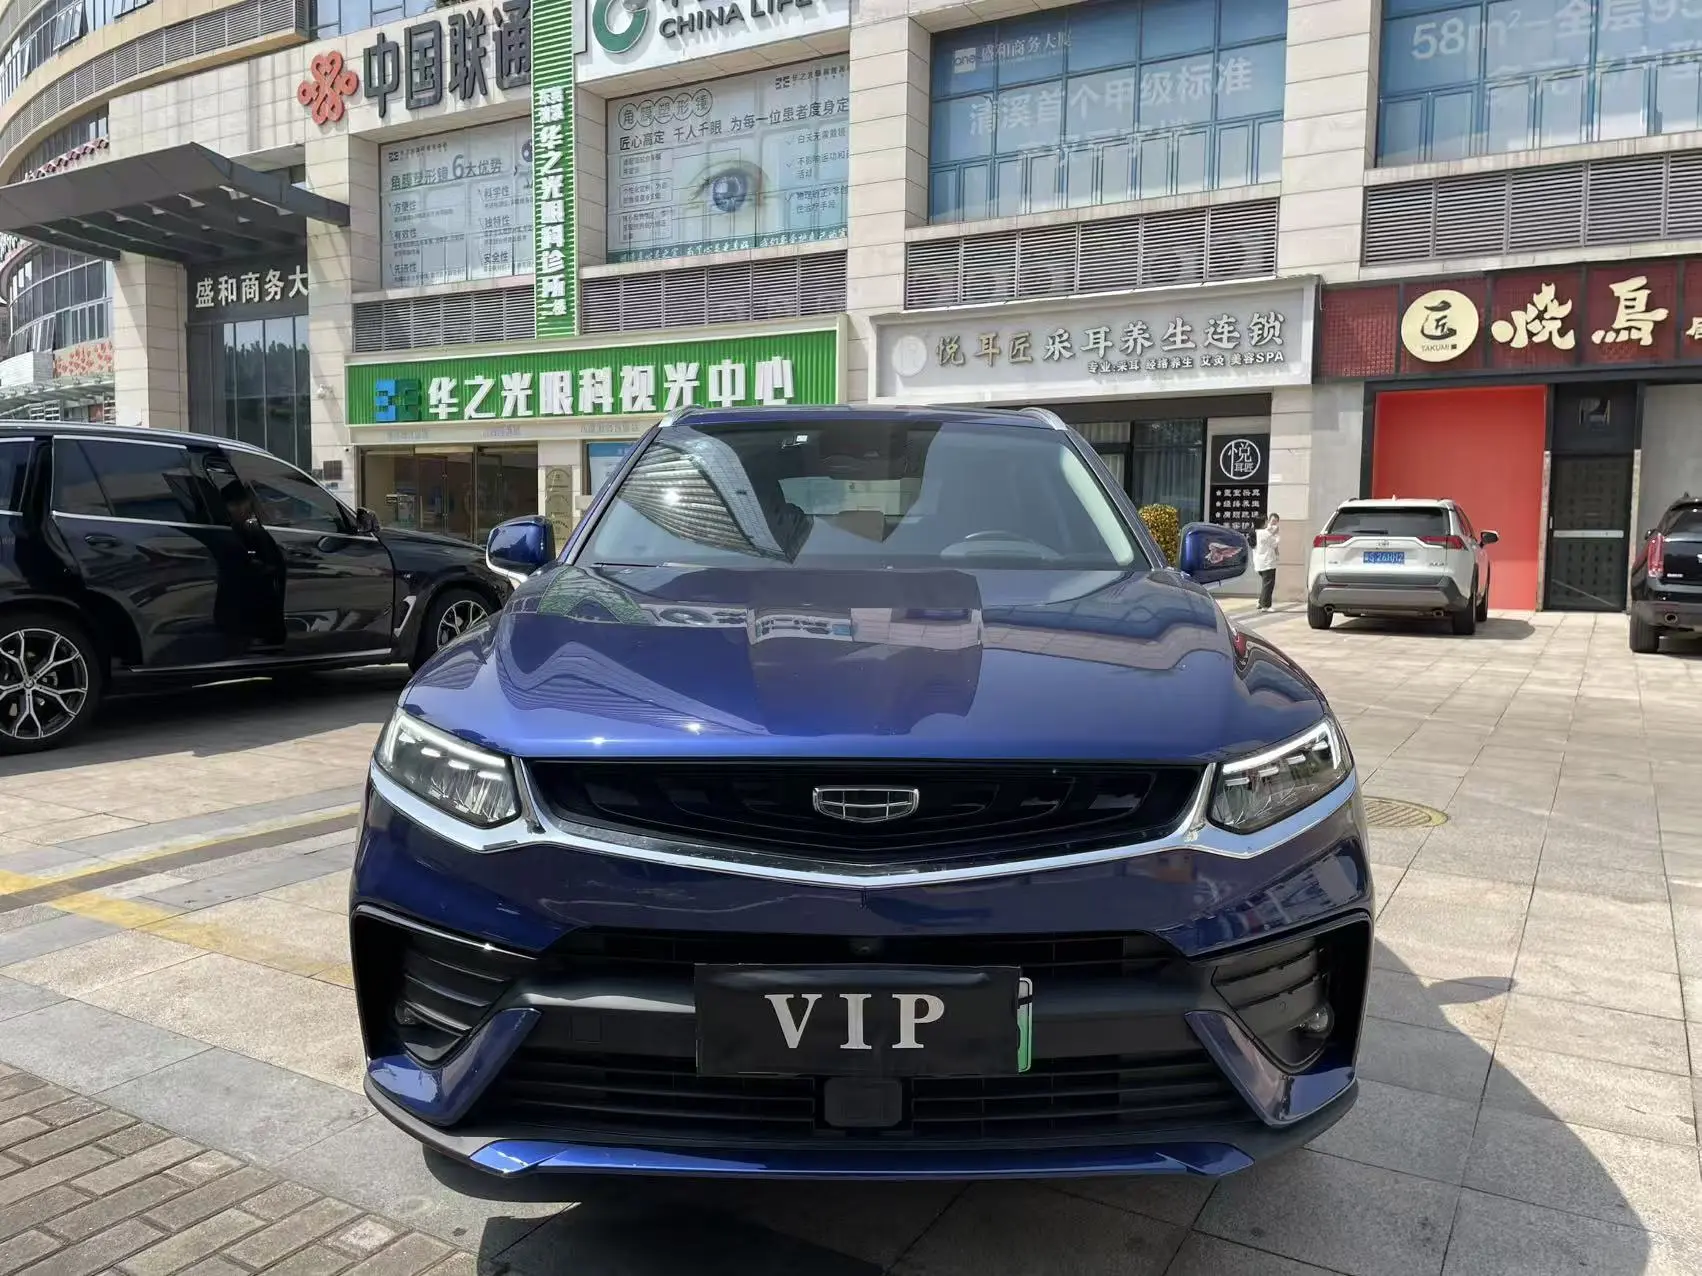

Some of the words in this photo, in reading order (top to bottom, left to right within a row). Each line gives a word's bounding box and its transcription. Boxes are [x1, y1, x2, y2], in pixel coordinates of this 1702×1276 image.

[659, 2, 745, 39] CHINA
[363, 0, 531, 118] 中国联通
[969, 57, 1252, 135] 清溪首个甲级标准
[674, 120, 722, 143] 千人千眼
[195, 265, 309, 308] 盛和商务大
[1420, 300, 1457, 341] 匠
[428, 356, 794, 420] 华之光眼科视光中心
[764, 993, 945, 1050] VIP
